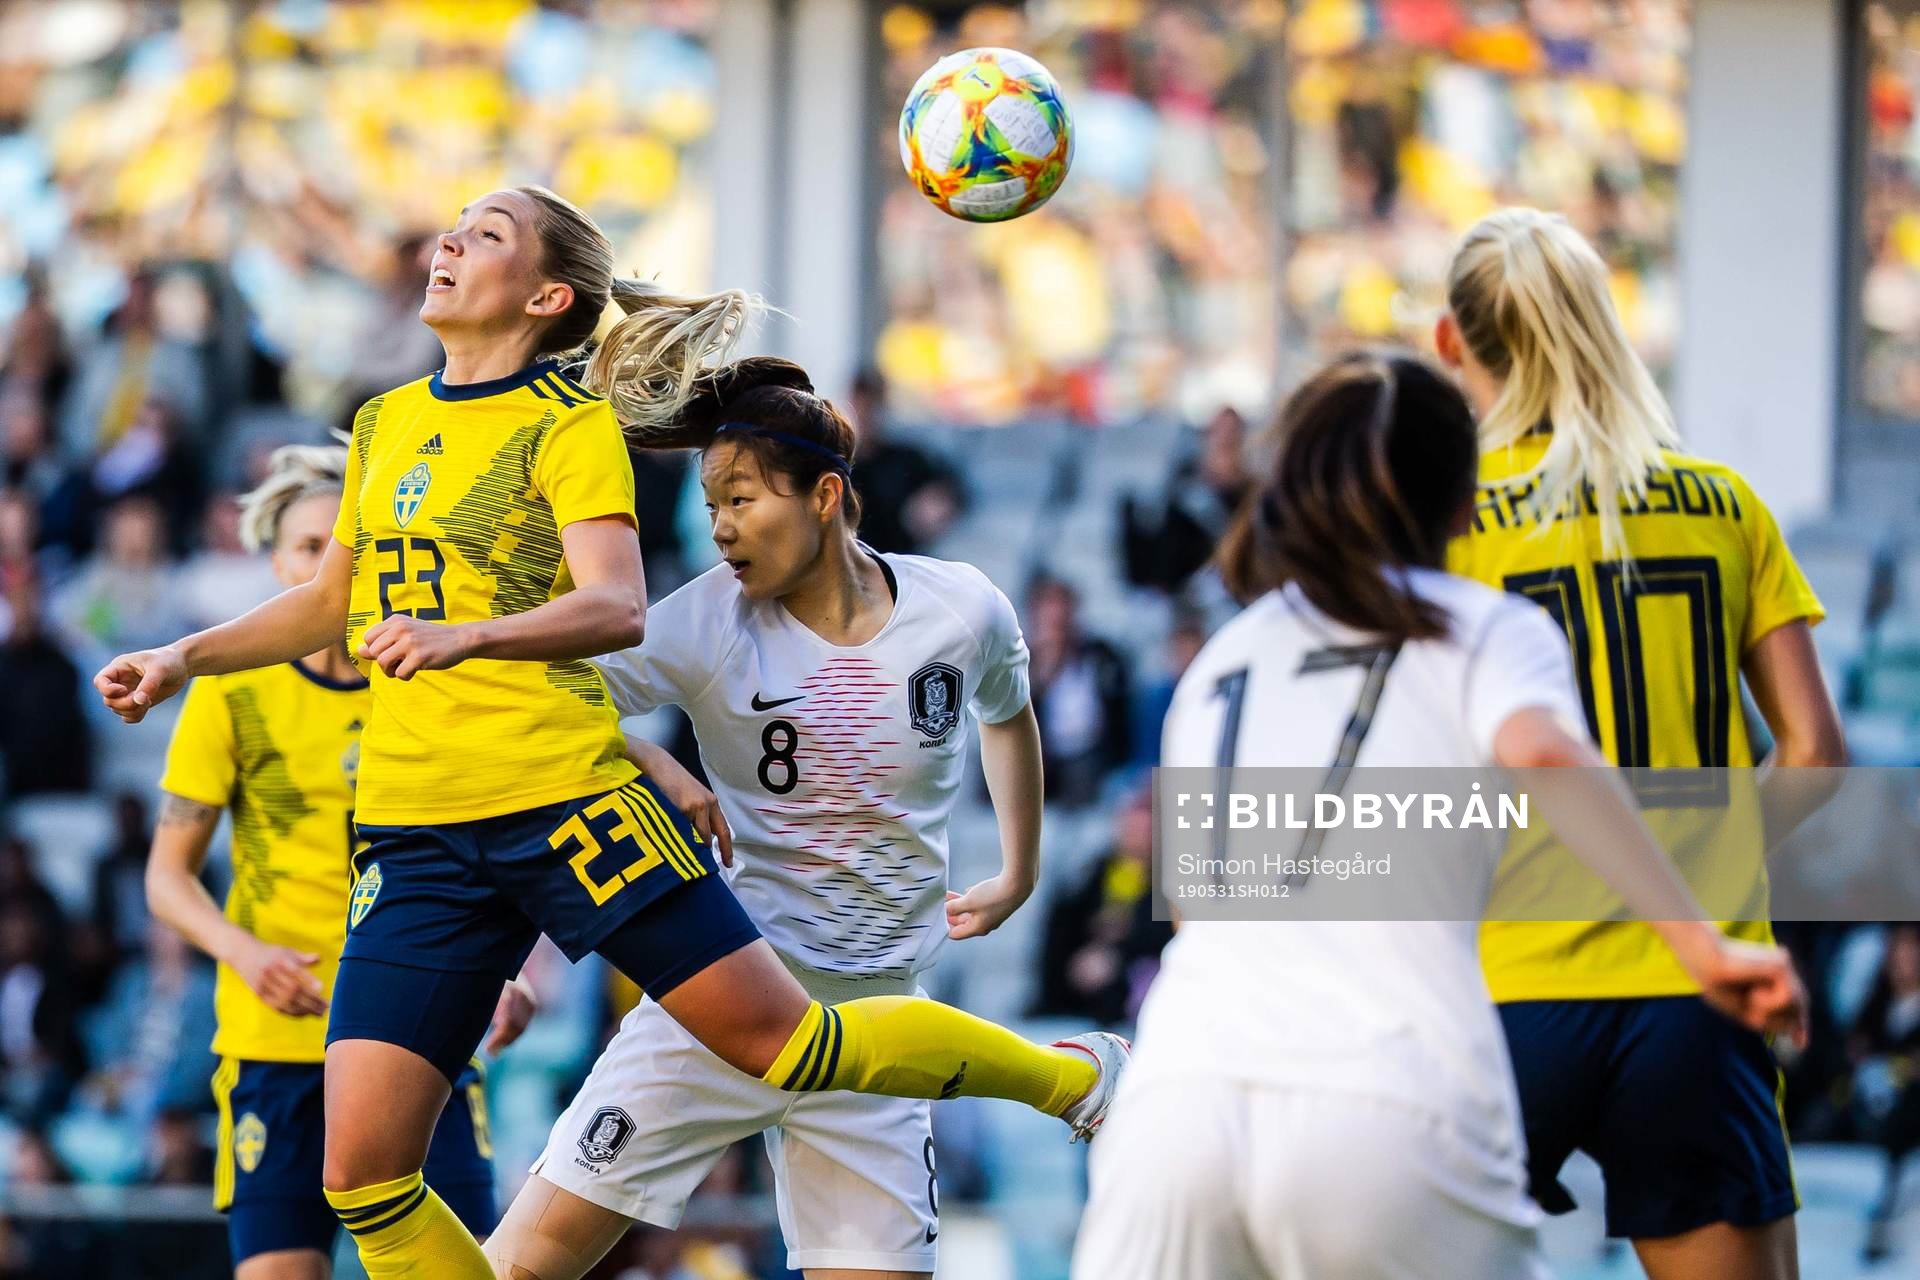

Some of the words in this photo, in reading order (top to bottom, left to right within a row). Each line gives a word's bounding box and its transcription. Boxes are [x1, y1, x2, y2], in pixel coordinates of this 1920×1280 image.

[416, 447, 444, 455] adidas
[375, 537, 446, 621] 23
[1503, 557, 1731, 811] 10
[758, 720, 798, 795] 8
[919, 738, 947, 749] KOREA
[1206, 643, 1403, 899] 17
[548, 790, 664, 907] 23
[574, 1157, 601, 1175] KOREA
